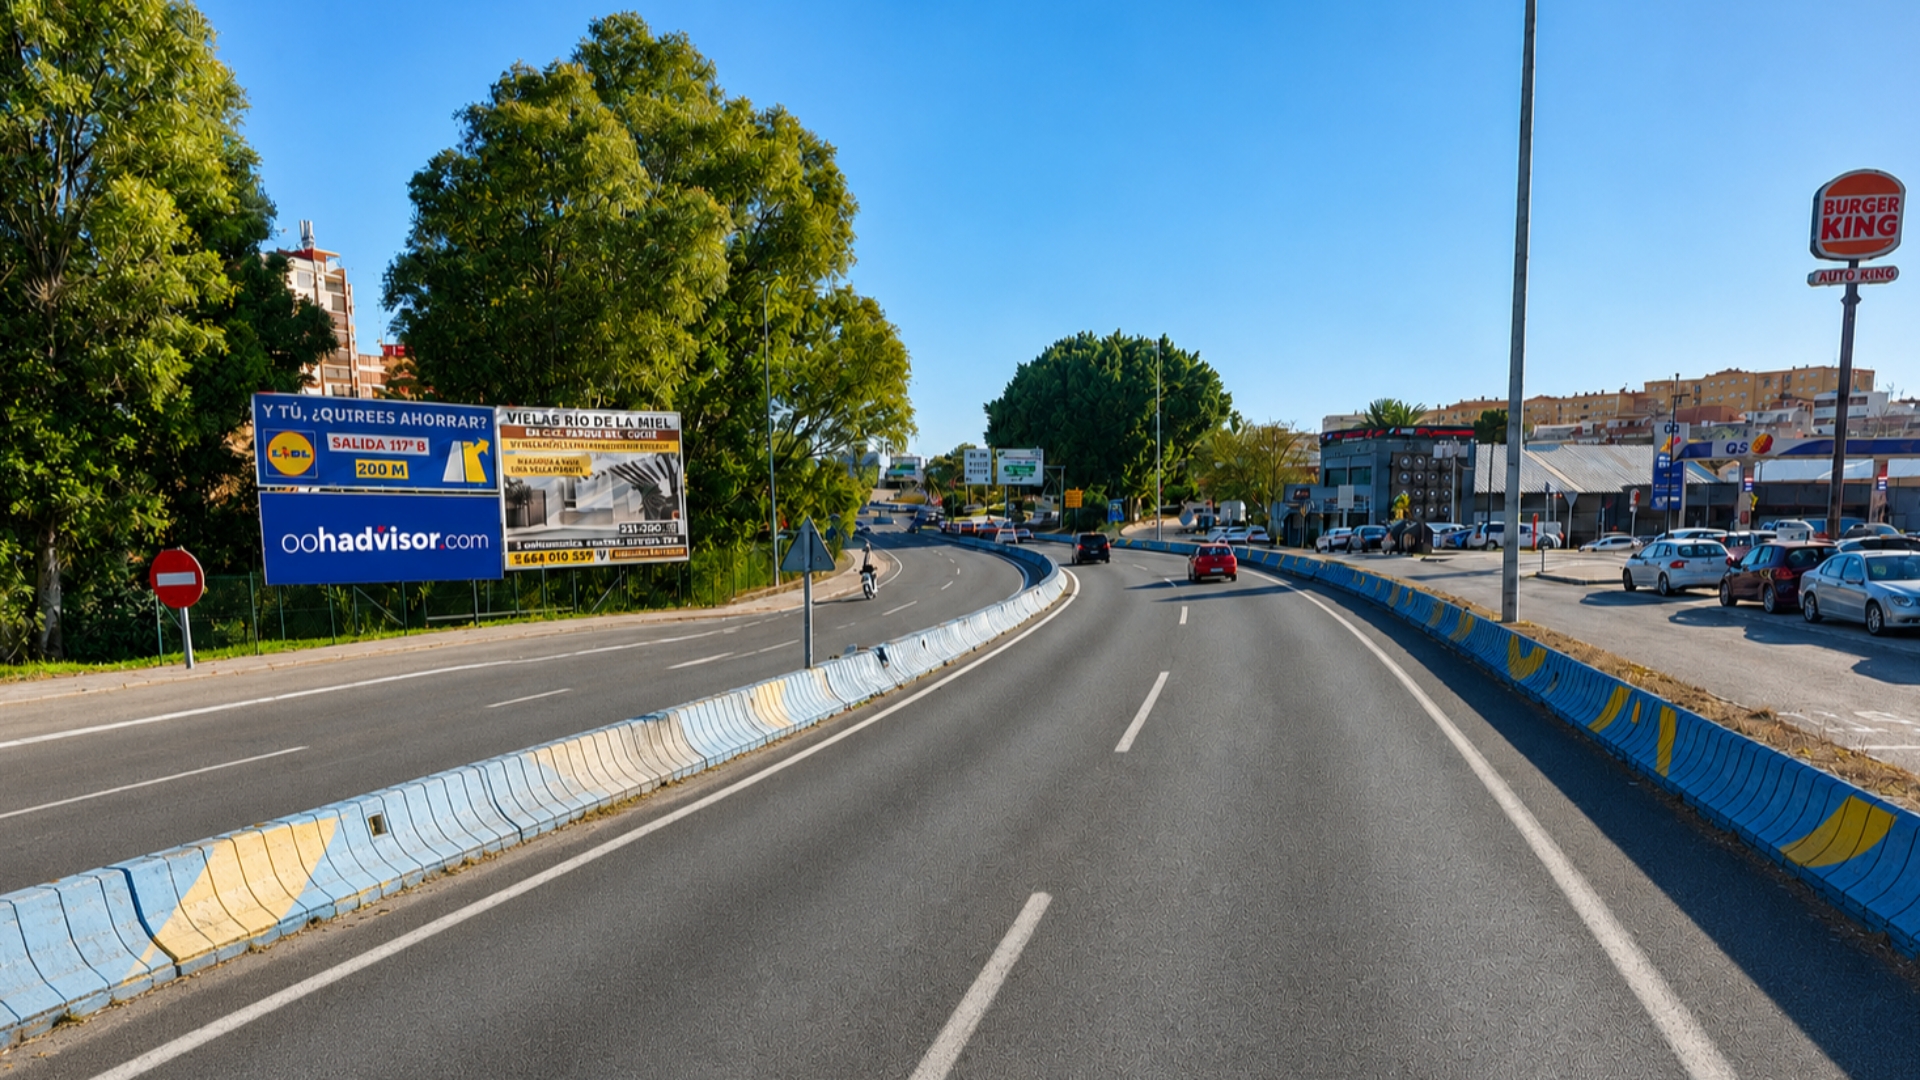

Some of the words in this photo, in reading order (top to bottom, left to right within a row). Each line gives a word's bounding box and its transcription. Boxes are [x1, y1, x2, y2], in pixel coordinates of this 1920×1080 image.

[1823, 197, 1900, 216] BURGER
[1821, 214, 1899, 241] KING
[1818, 269, 1856, 283] AUTO
[1860, 267, 1895, 281] KING
[262, 403, 274, 419] Y
[278, 401, 307, 423] TÚ,
[400, 411, 488, 430] AHORRAR?
[593, 415, 613, 428] DE
[615, 416, 634, 428] LA
[638, 416, 672, 430] MIEL
[271, 446, 311, 459] LIDL
[331, 436, 386, 451] SALIDA
[416, 440, 427, 453] B
[357, 462, 387, 476] 200
[391, 463, 406, 477] M
[281, 524, 490, 554] oohadvisor.com
[548, 551, 569, 562] 010
